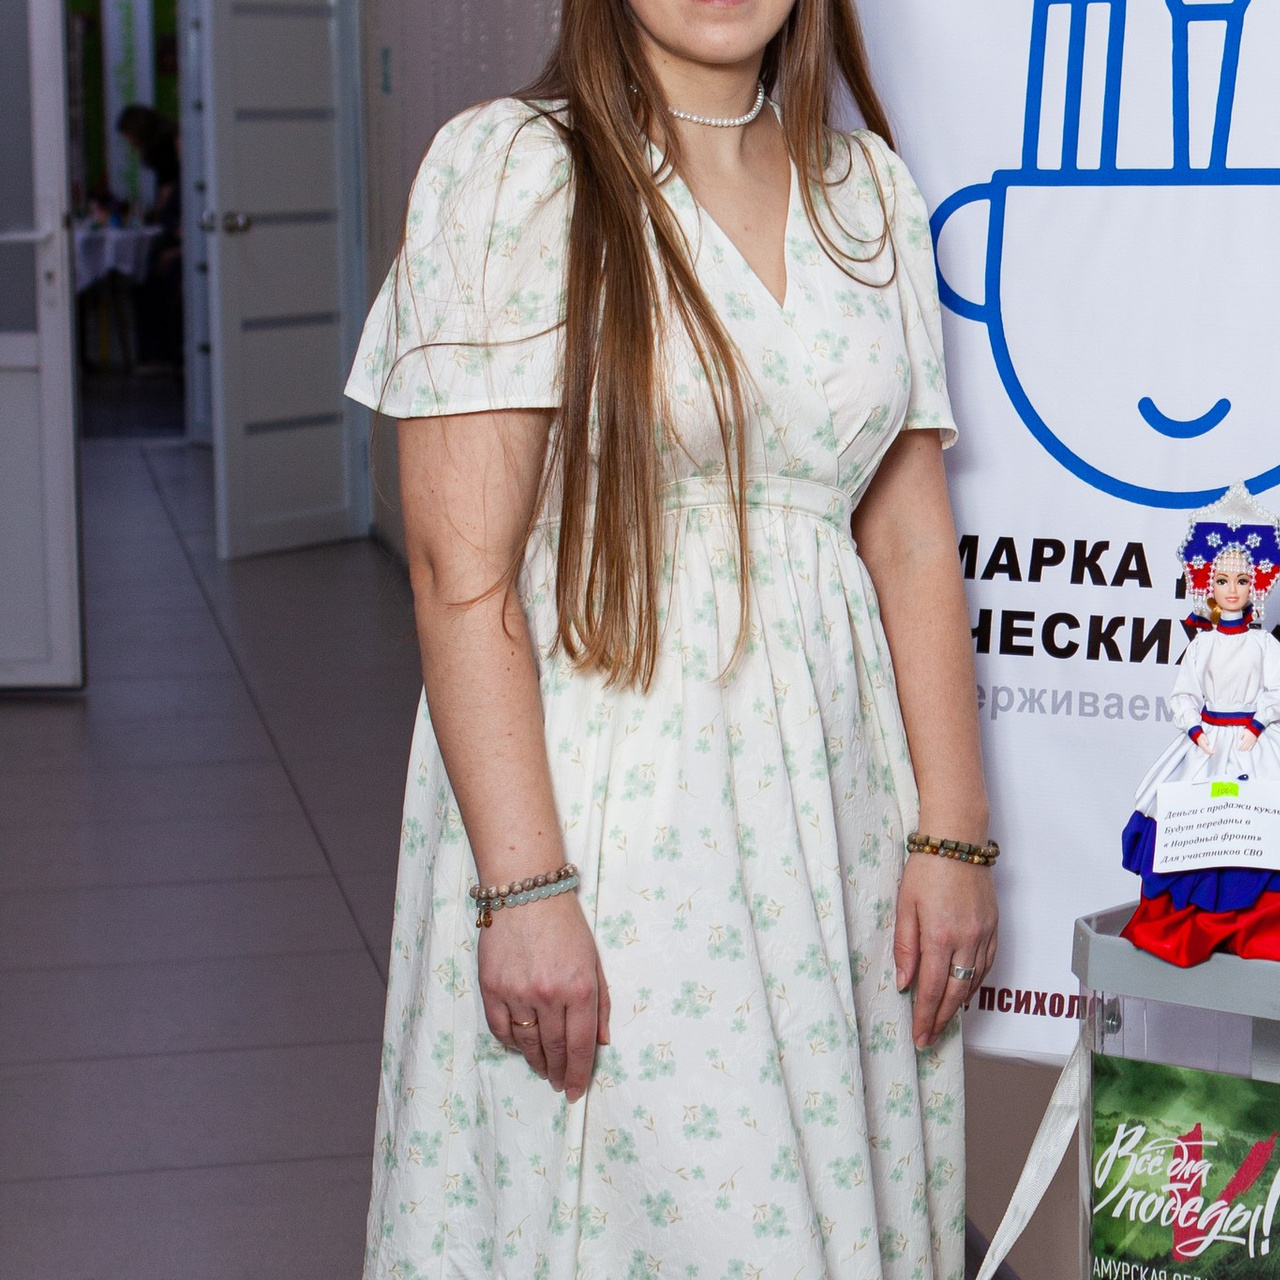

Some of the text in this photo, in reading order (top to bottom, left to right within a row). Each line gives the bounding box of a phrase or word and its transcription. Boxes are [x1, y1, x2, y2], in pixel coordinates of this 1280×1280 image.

[1164, 808, 1198, 820] Деньги
[1206, 801, 1252, 813] продажи
[1164, 824, 1194, 835] Будут
[1196, 818, 1243, 831] переданы
[1170, 833, 1219, 849] Народный
[1160, 849, 1263, 864] Для участников СВО
[1094, 1123, 1218, 1214] Всё для
